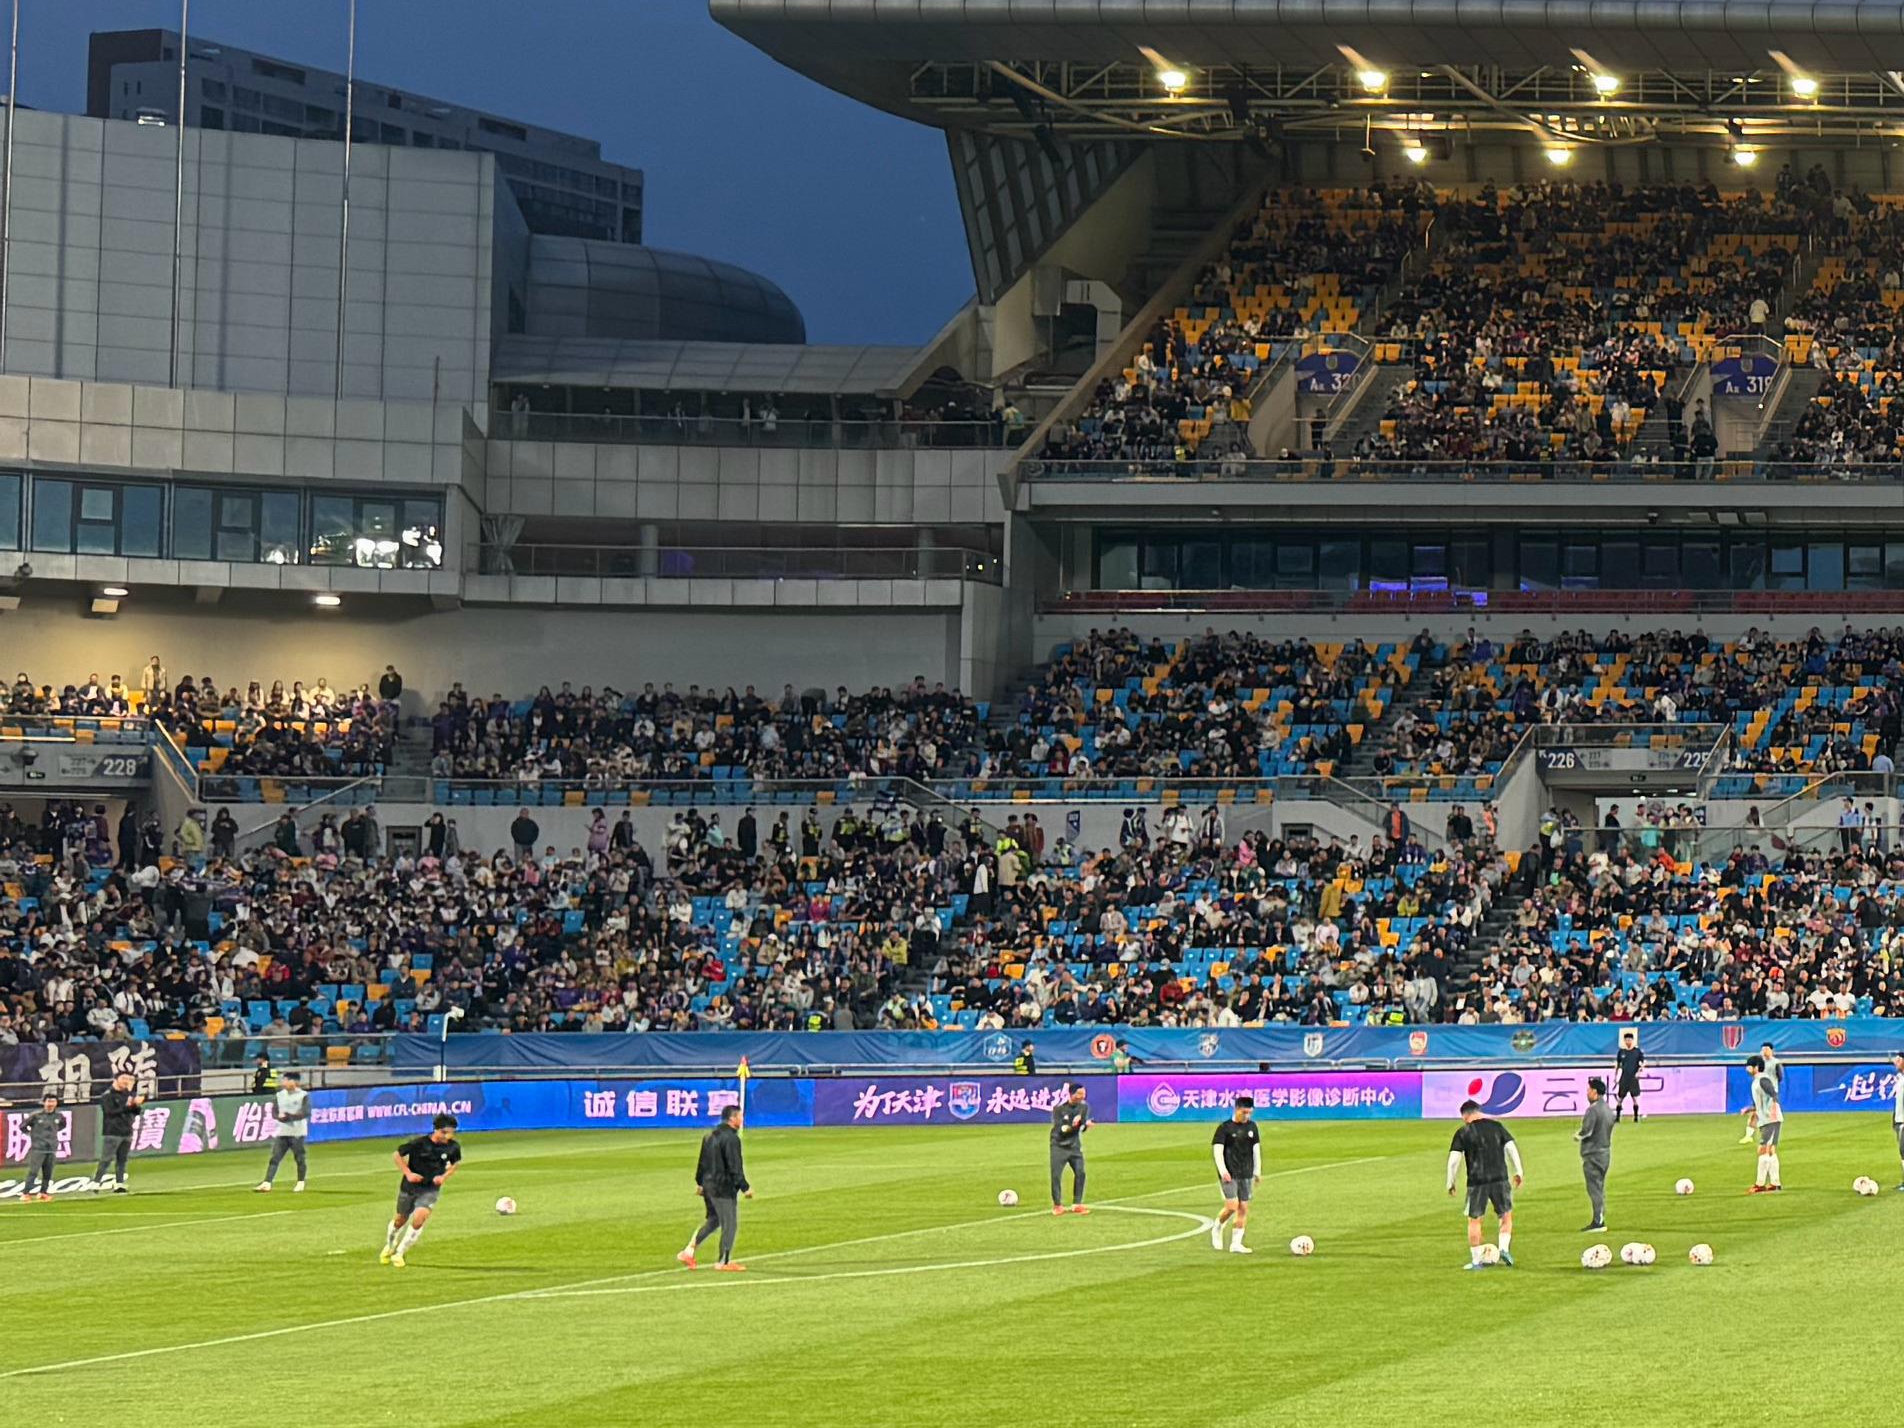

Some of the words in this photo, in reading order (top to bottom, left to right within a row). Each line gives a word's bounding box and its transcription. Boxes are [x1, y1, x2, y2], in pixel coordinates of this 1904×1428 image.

[103, 758, 136, 776] 228
[1548, 752, 1575, 769] 226
[583, 1090, 741, 1119] 诚信联赛
[852, 1085, 945, 1120] 为了天津
[1542, 1073, 1665, 1113] 云户
